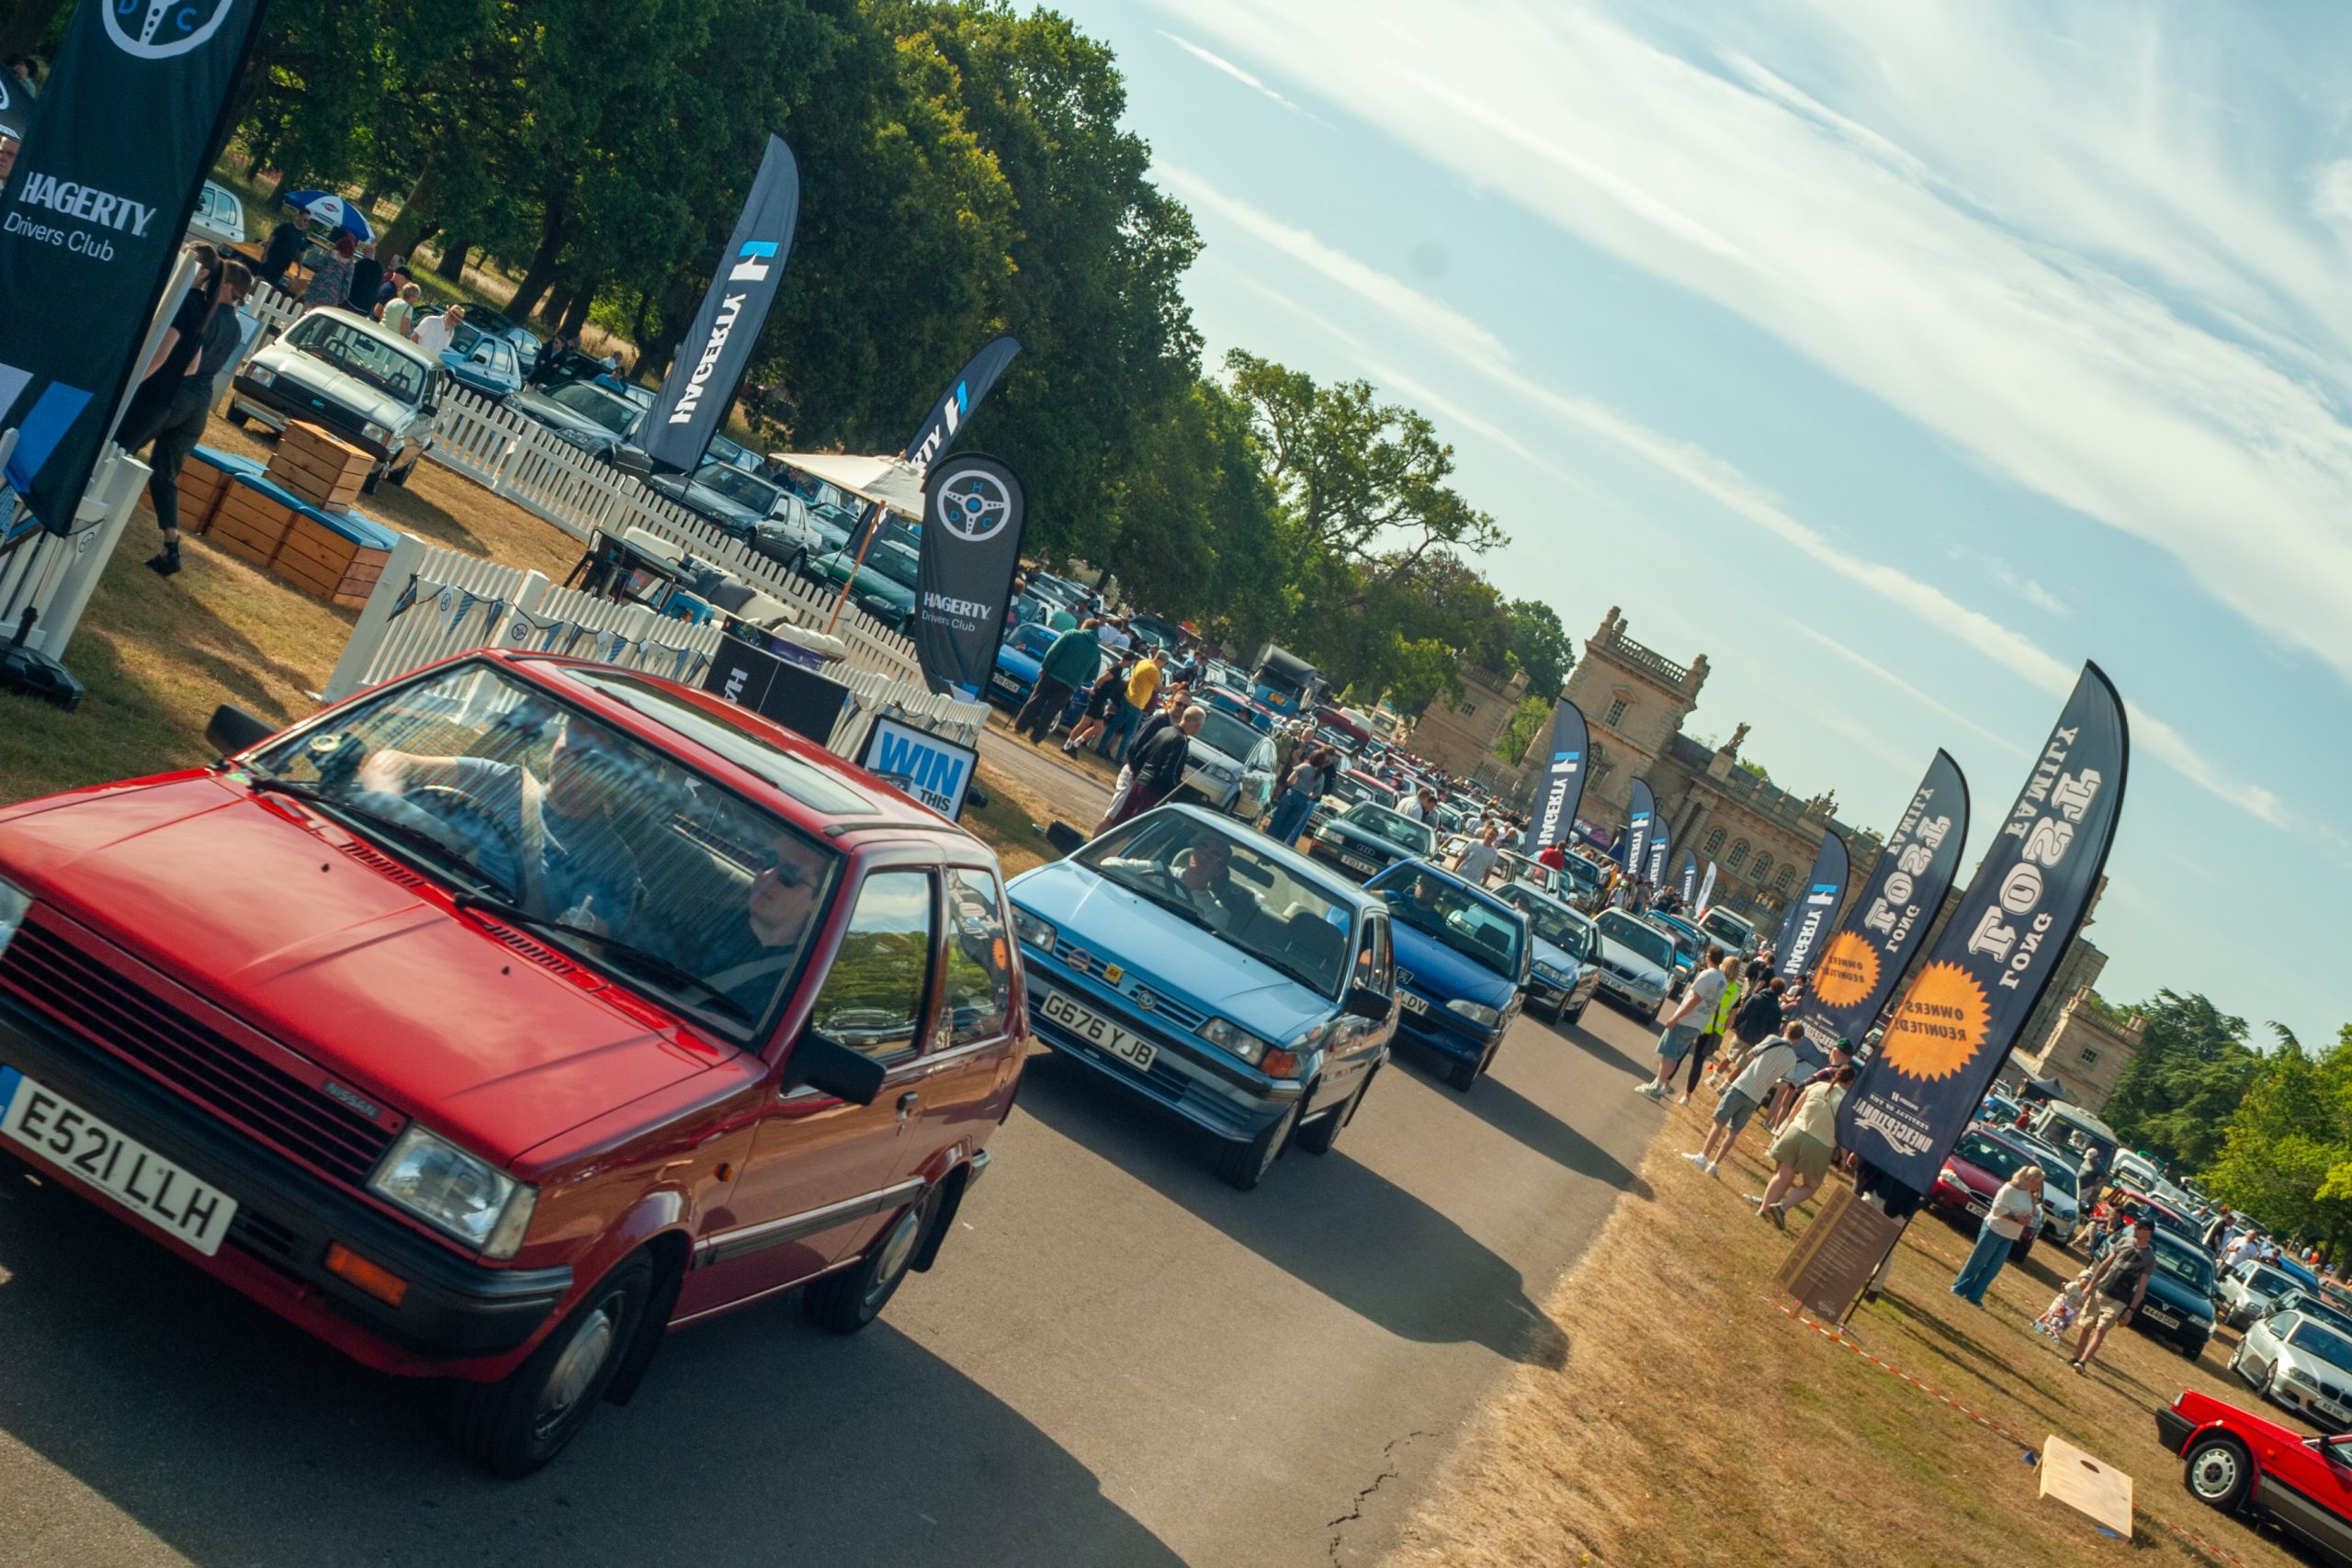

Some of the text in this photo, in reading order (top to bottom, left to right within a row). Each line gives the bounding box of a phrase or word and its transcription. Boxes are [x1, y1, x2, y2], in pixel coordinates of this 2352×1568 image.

[175, 8, 198, 30] C
[18, 171, 157, 238] HAGERTY
[4, 211, 115, 263] Drivers Club
[971, 481, 984, 493] H
[949, 509, 961, 522] D
[981, 515, 992, 528] C
[923, 591, 992, 620] HAGERTY
[922, 610, 976, 632] Drivers Club
[879, 731, 964, 798] WIN
[921, 789, 951, 812] THIS
[1046, 995, 1152, 1066] G676 YJB
[18, 1091, 124, 1182] E521
[123, 1152, 220, 1240] LLH
